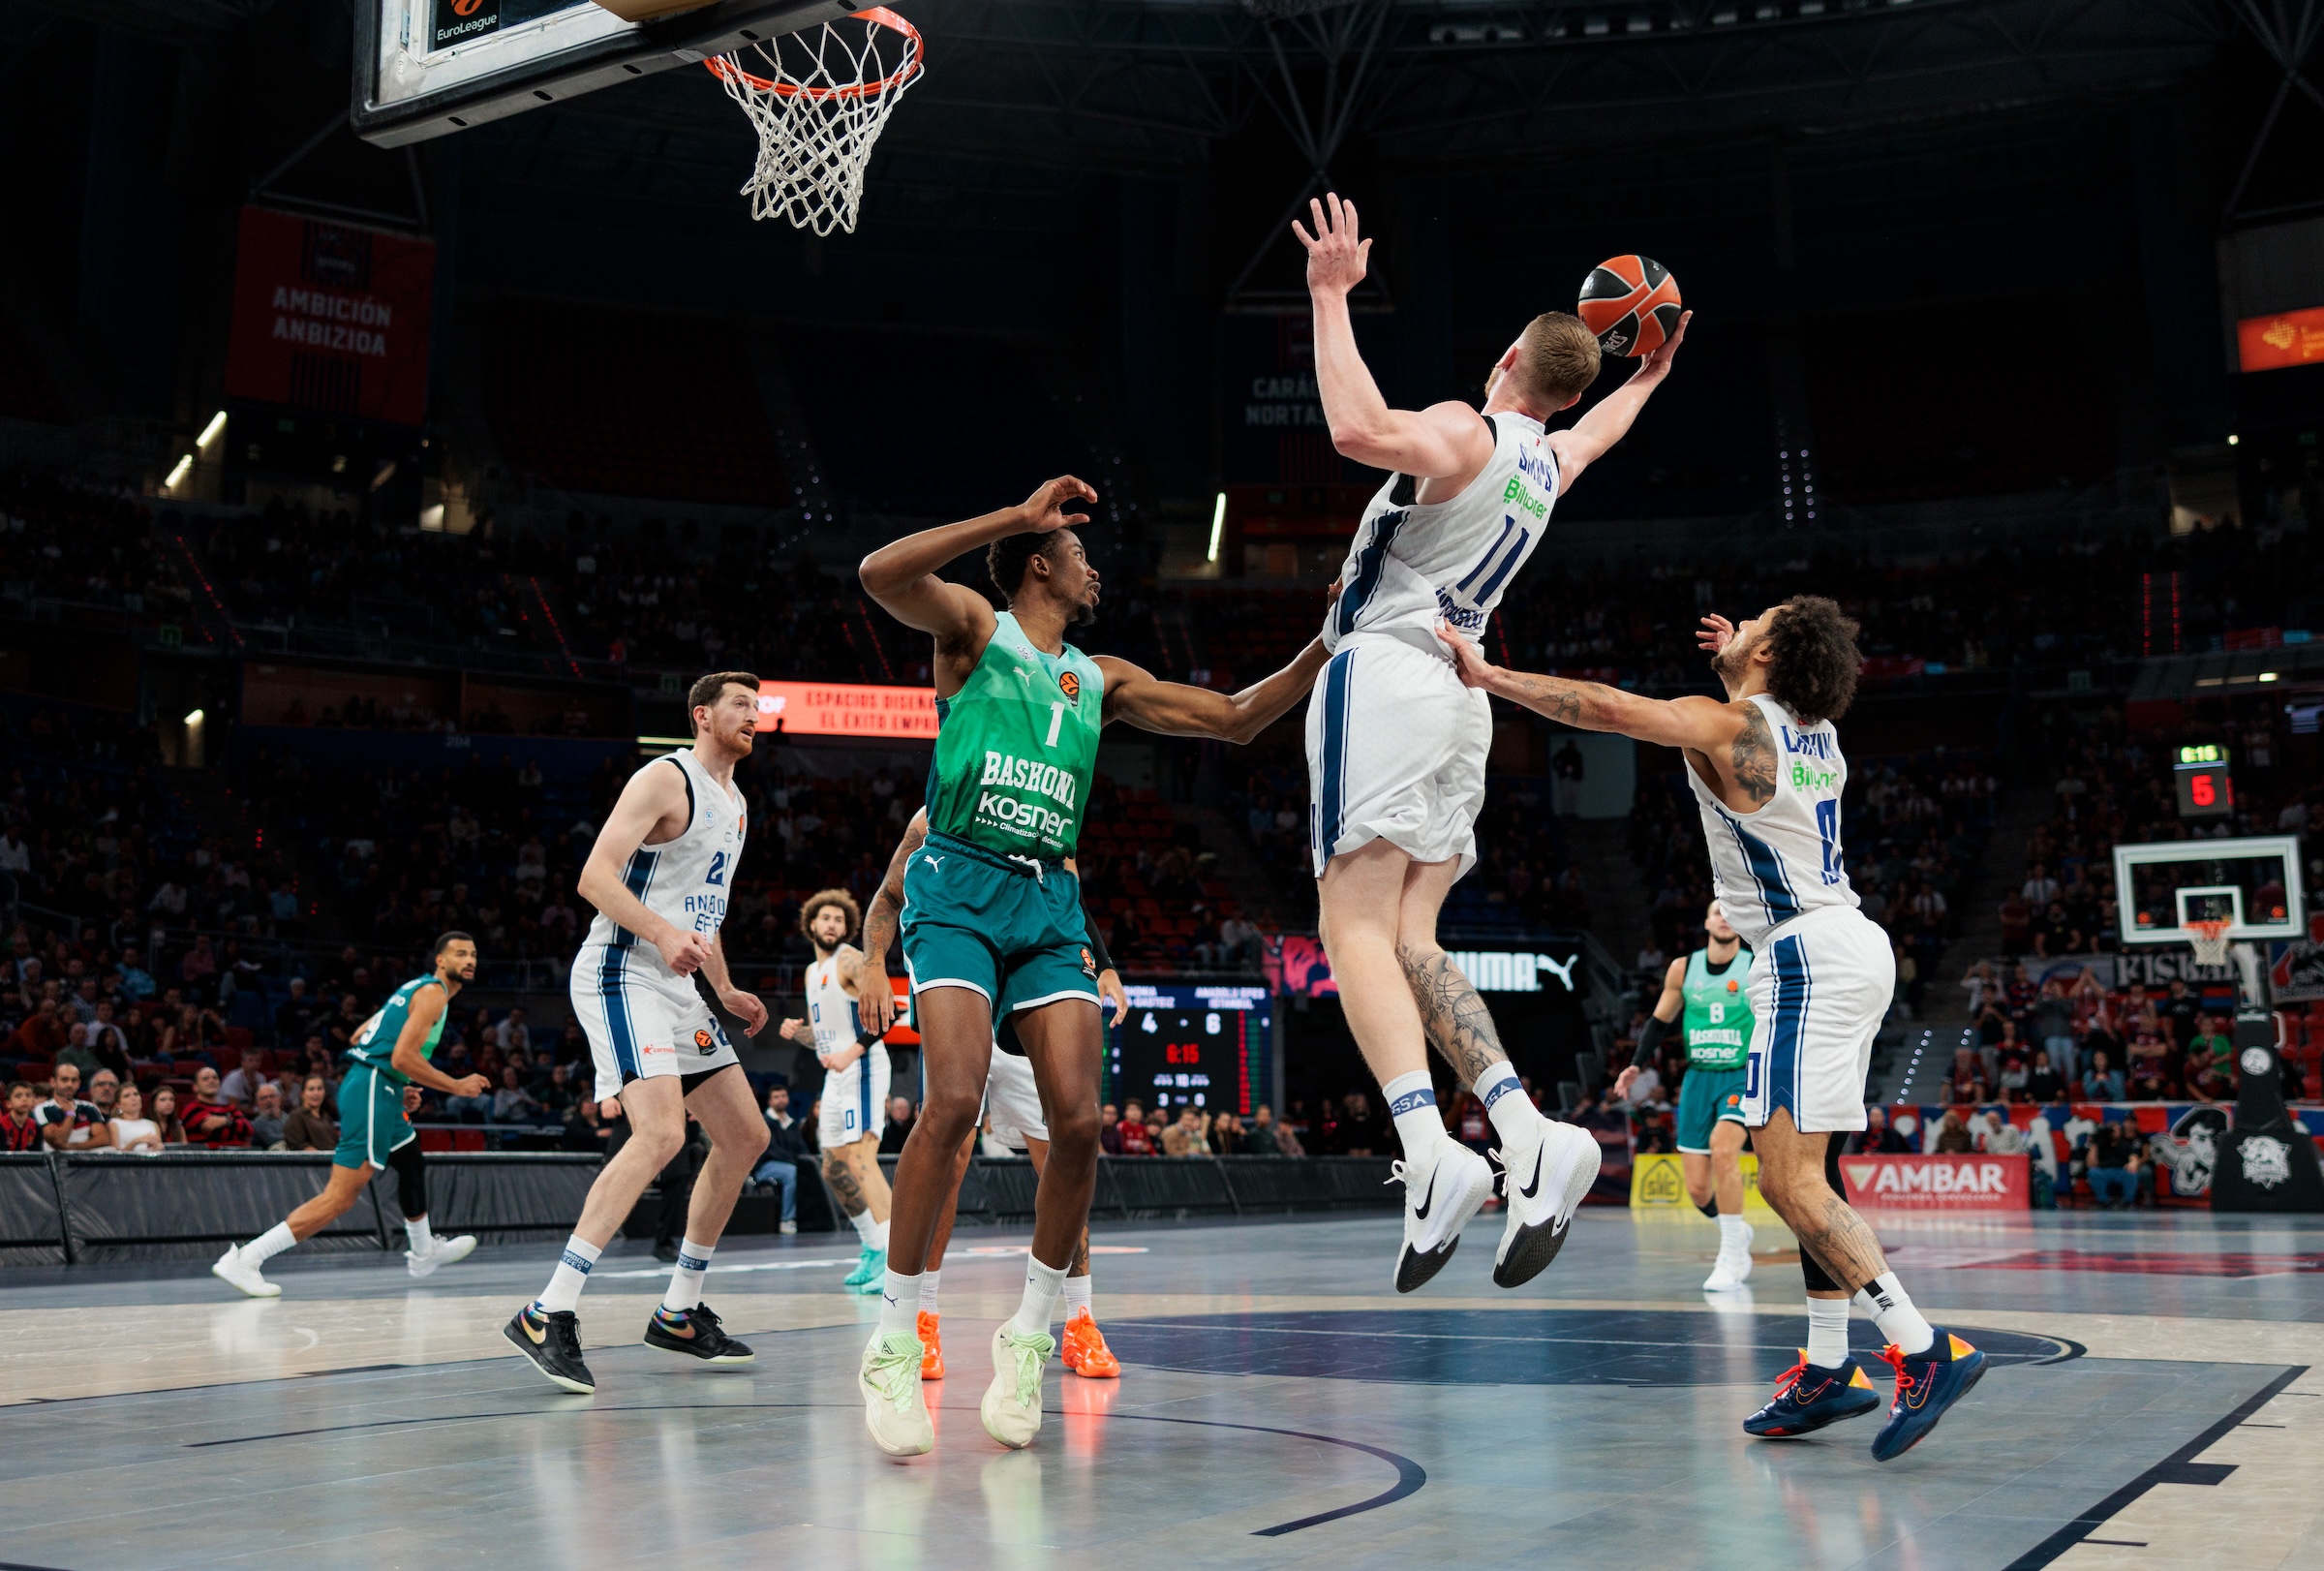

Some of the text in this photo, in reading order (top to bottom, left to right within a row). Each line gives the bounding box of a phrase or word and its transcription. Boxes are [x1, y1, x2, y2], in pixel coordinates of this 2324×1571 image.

[437, 15, 498, 41] EuroLeague
[273, 287, 391, 327] AMBICIÓN
[273, 317, 385, 356] ANBIZIOA
[1455, 513, 1530, 608] 11
[1045, 700, 1065, 748] 1
[980, 750, 1075, 812] BASKONI
[2191, 775, 2216, 807] 5
[1449, 951, 1537, 992] UMA
[1142, 1012, 1221, 1034] 4 6
[1166, 1043, 1200, 1064] 6:15
[845, 1109, 854, 1130] 0
[1874, 1162, 2008, 1193] AMBAR
